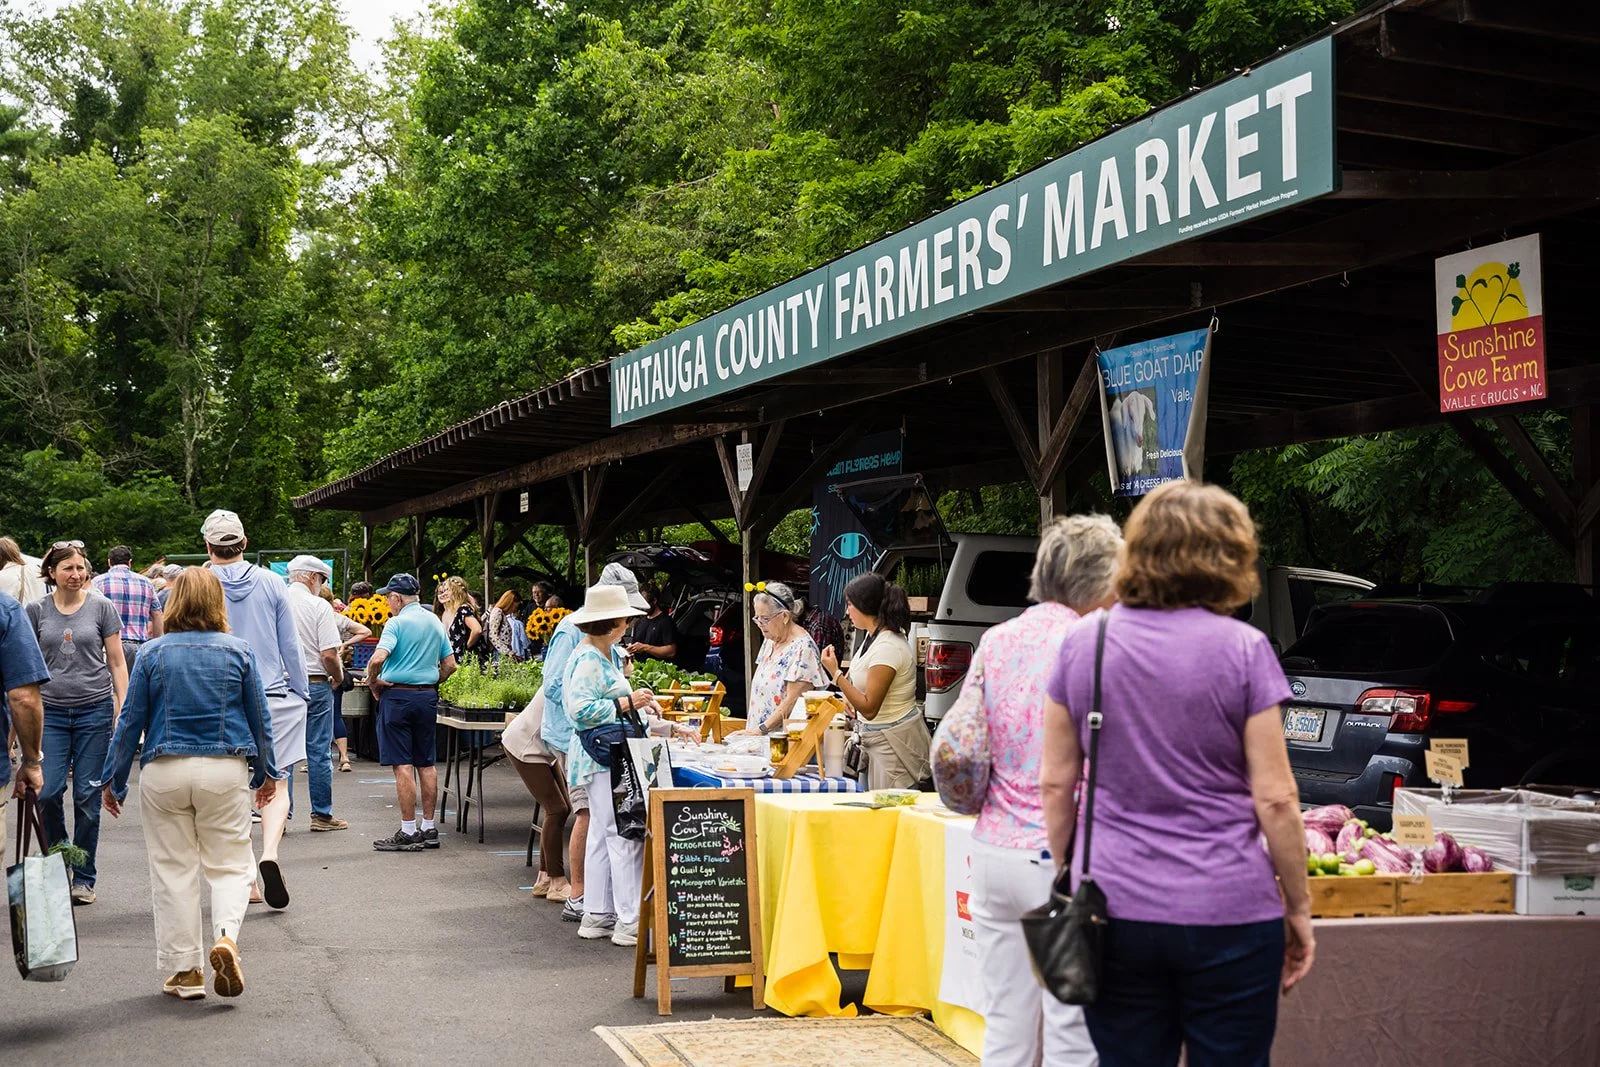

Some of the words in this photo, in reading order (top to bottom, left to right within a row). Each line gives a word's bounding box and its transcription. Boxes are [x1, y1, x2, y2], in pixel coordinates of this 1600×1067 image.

[1218, 212, 1229, 221] USDA
[1246, 202, 1260, 212] Market
[1280, 189, 1298, 200] Program
[614, 334, 710, 414] WATAUGA
[714, 283, 826, 381] COUNTY
[1042, 71, 1313, 267] MARKET
[1444, 326, 1536, 362] Sunshine
[1102, 364, 1132, 388] BLUE
[1134, 356, 1168, 383] GOAT
[1444, 365, 1488, 392] Cove
[1490, 355, 1538, 384] Farm
[1443, 394, 1477, 410] VALLE
[1480, 388, 1518, 404] CRUCIS
[1530, 383, 1542, 396] NC
[1146, 450, 1159, 460] Fresh
[1160, 448, 1183, 458] Delicious
[621, 758, 634, 801] Audubon
[678, 806, 729, 822] Sunshine
[672, 822, 698, 835] Cove
[701, 821, 727, 837] Farm
[670, 841, 722, 849] MICROGREENS
[680, 854, 701, 863] Edible
[704, 855, 730, 863] Flowers
[680, 865, 697, 874] Quail
[700, 865, 716, 877] Eggs
[681, 879, 716, 888] Microgreen
[686, 893, 712, 902] Market
[713, 893, 725, 902] Mix
[709, 910, 725, 919] Gallo
[707, 928, 732, 938] Arugula
